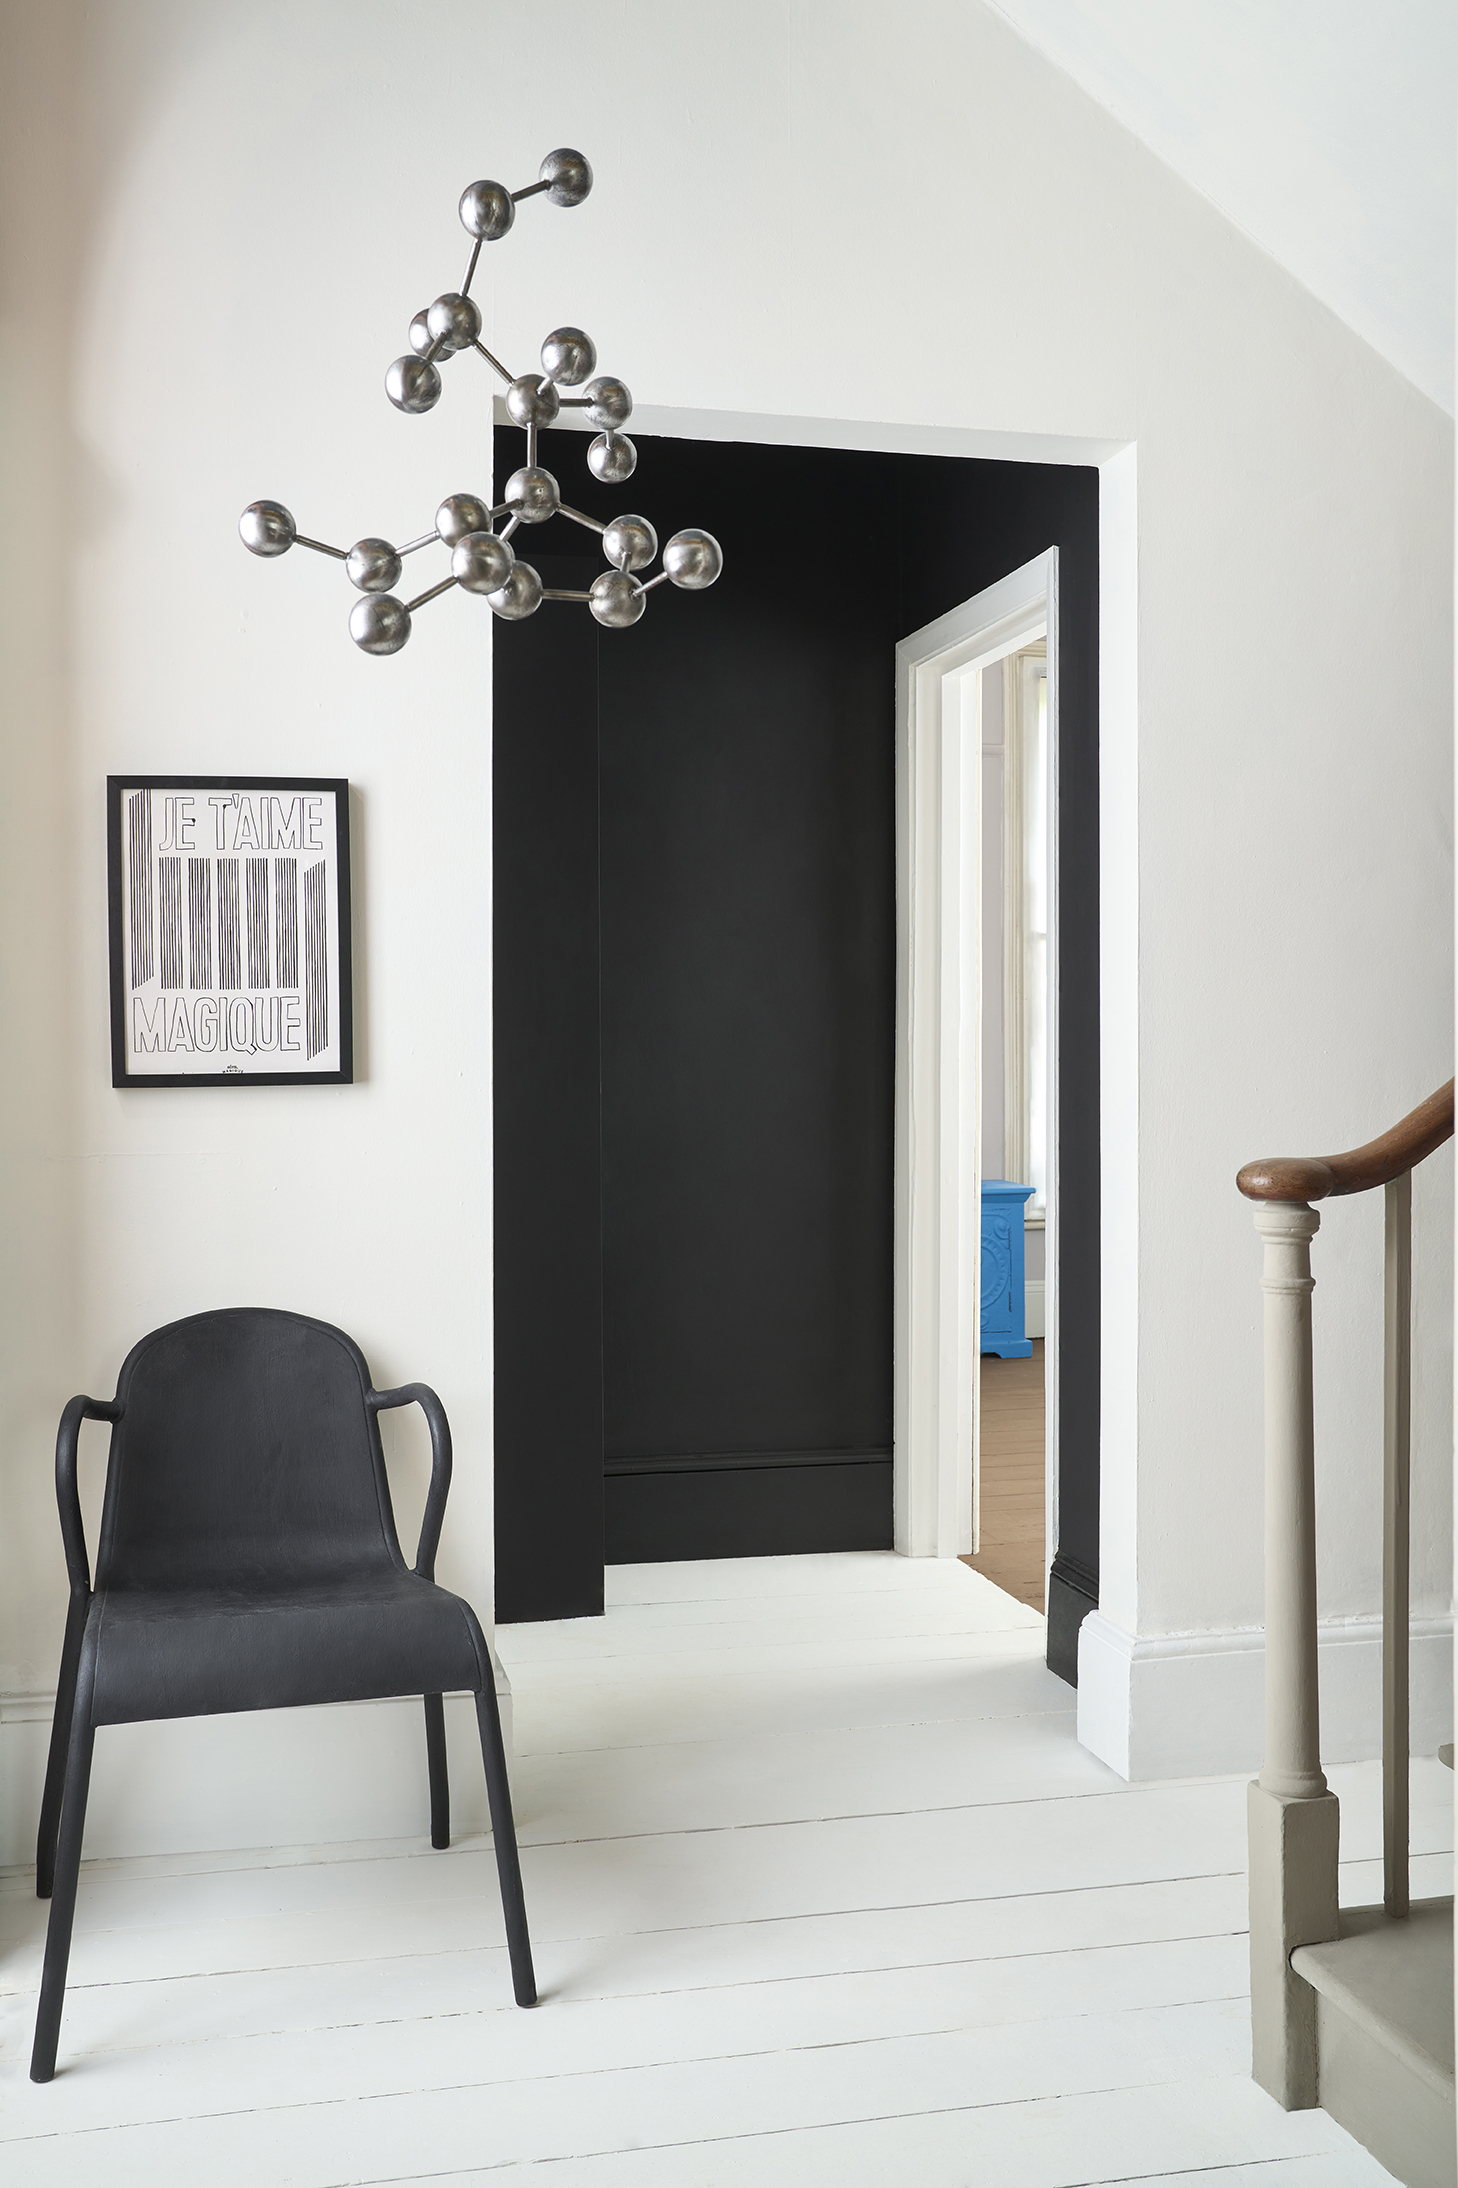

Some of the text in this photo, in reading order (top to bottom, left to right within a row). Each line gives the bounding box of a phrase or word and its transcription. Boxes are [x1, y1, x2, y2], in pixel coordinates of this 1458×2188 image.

[158, 793, 323, 851] JE T'AIME
[133, 996, 301, 1056] MAGIQUE
